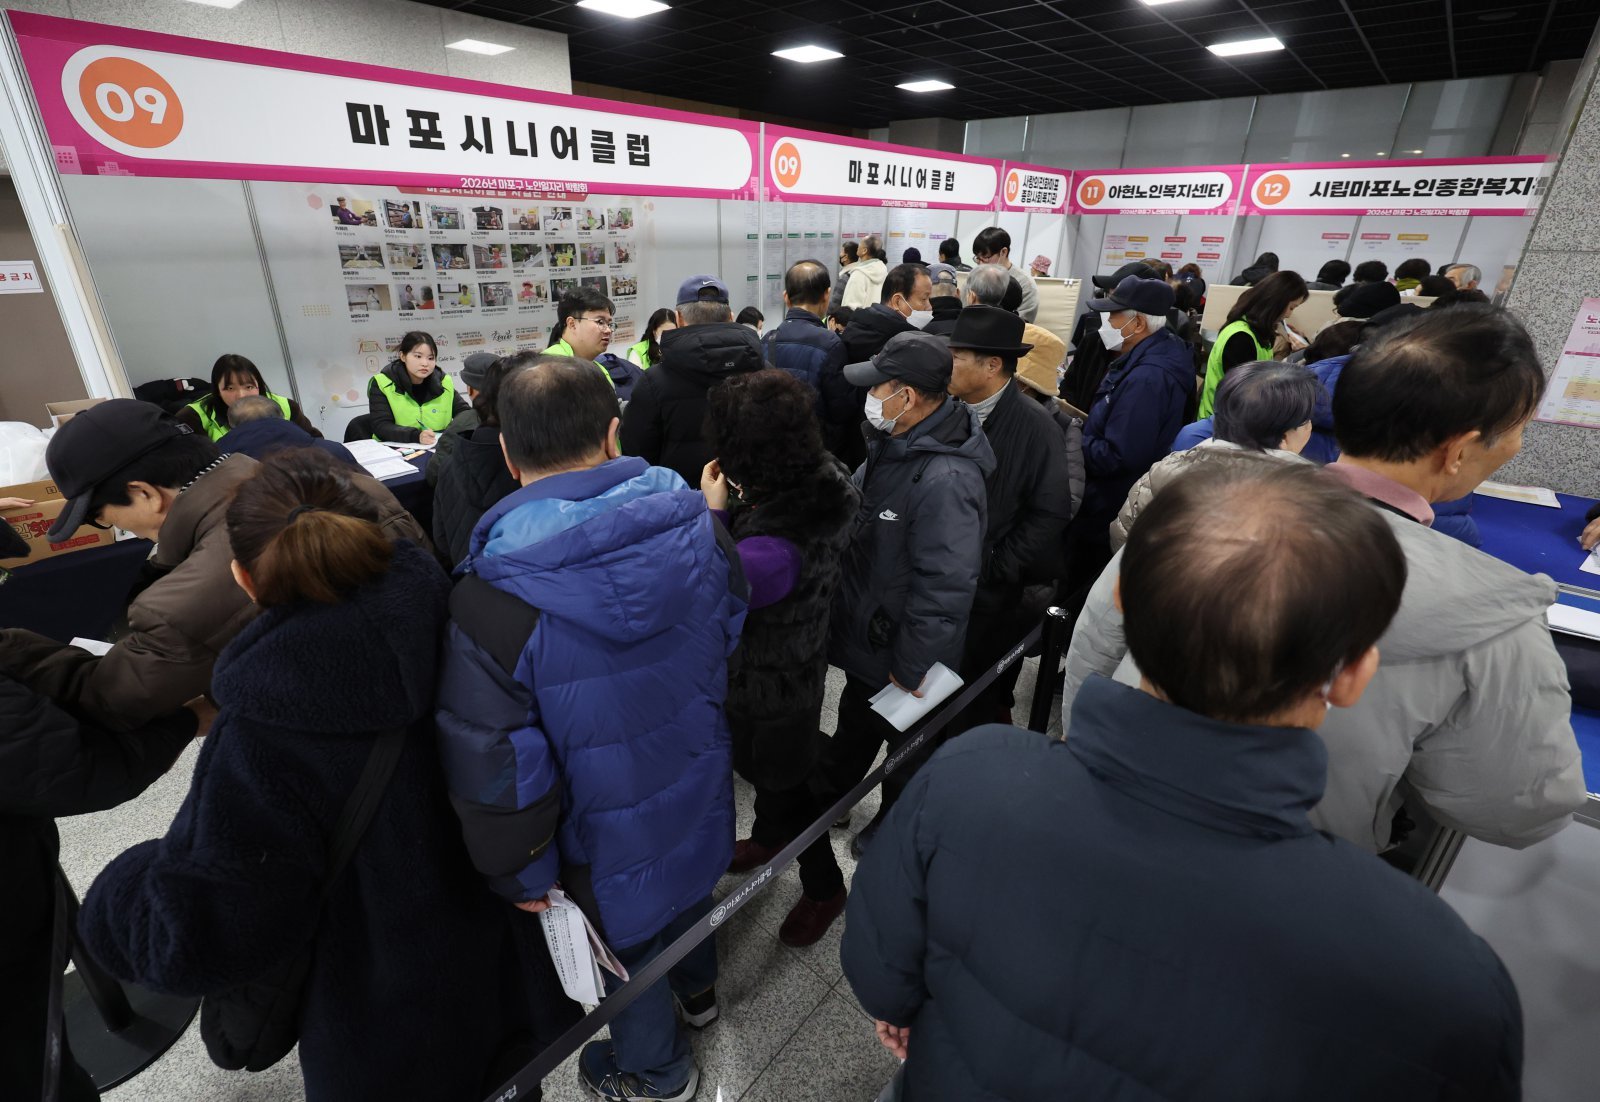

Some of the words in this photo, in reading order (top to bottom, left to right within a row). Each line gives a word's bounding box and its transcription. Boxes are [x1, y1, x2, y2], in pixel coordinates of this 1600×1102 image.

[95, 82, 168, 125] 09
[345, 101, 651, 168] 마포시니어클럽
[777, 154, 798, 176] 09
[848, 159, 955, 192] 마포시니어클럽
[461, 177, 499, 190] 2026년
[499, 179, 525, 191] 마포구
[525, 181, 565, 193] 노인일자리
[1007, 180, 1017, 194] 10
[1086, 186, 1099, 199] 11
[1108, 183, 1224, 199] 아현노인복지센터
[1263, 182, 1282, 197] 12
